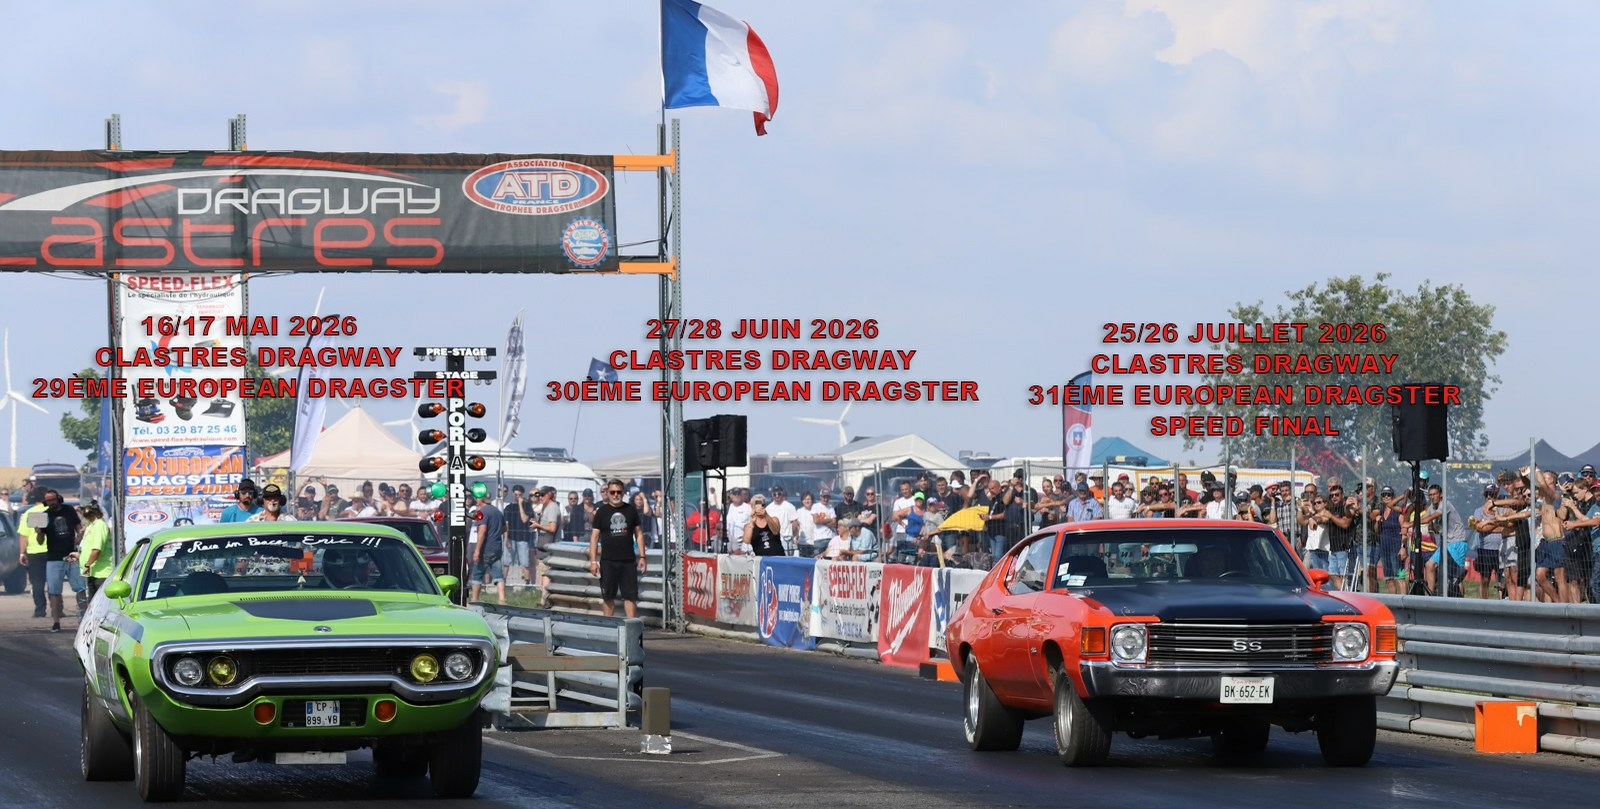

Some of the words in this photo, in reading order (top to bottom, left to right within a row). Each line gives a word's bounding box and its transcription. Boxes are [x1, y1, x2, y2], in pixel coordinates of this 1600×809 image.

[507, 160, 566, 168] ASSOCIATION
[491, 171, 580, 200] ATD
[177, 187, 441, 214] DRAGWAY
[495, 202, 533, 214] TROPHEE
[0, 216, 444, 266] astres
[127, 275, 234, 290] SPEED-FLEX
[426, 347, 487, 356] PRE-STAGE
[435, 371, 479, 379] STAGE
[132, 427, 153, 435] Tél.
[156, 426, 170, 434] 03
[173, 426, 187, 434] 29
[190, 426, 204, 434] 87
[207, 425, 221, 433] 25
[224, 425, 238, 433] 46
[126, 446, 157, 476] 28
[157, 455, 244, 476] EUROPEAN
[126, 474, 243, 486] DRAGSTER
[225, 541, 243, 549] in
[1233, 640, 1262, 652] SS
[1224, 685, 1270, 698] BK-652-EK
[306, 715, 322, 725] 899
